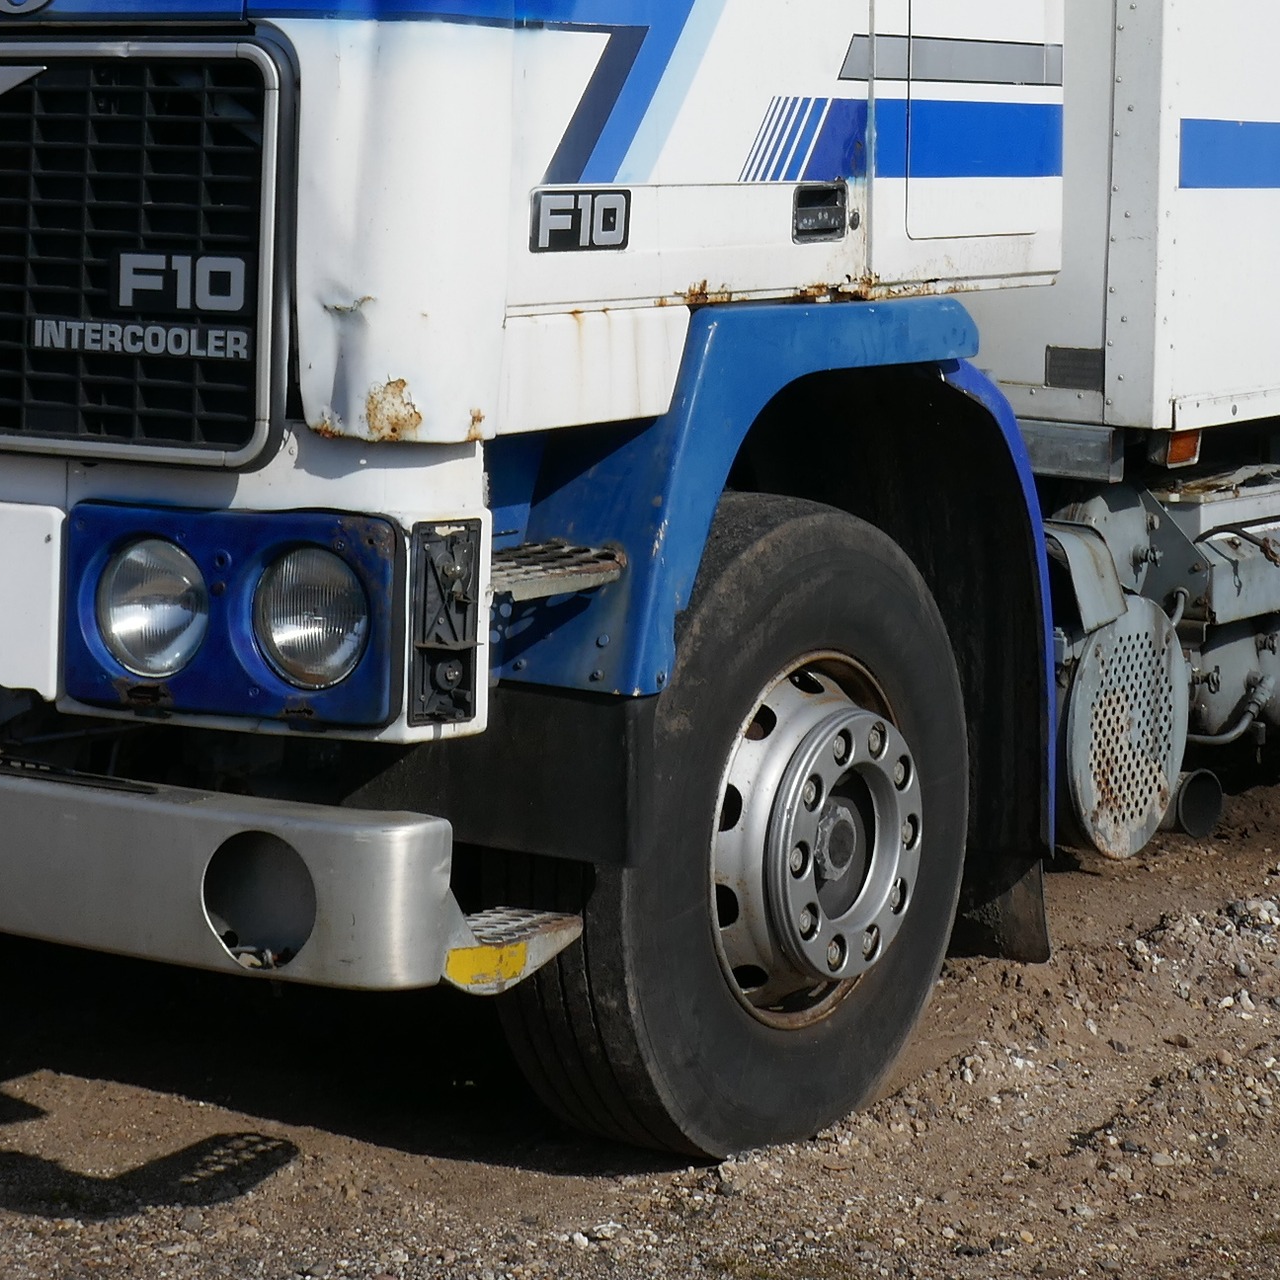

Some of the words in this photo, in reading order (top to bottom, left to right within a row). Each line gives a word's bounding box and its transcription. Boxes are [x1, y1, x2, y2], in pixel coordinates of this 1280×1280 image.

[538, 194, 626, 247] F10
[119, 253, 246, 312] F10
[34, 319, 249, 360] INTERCOOLER
